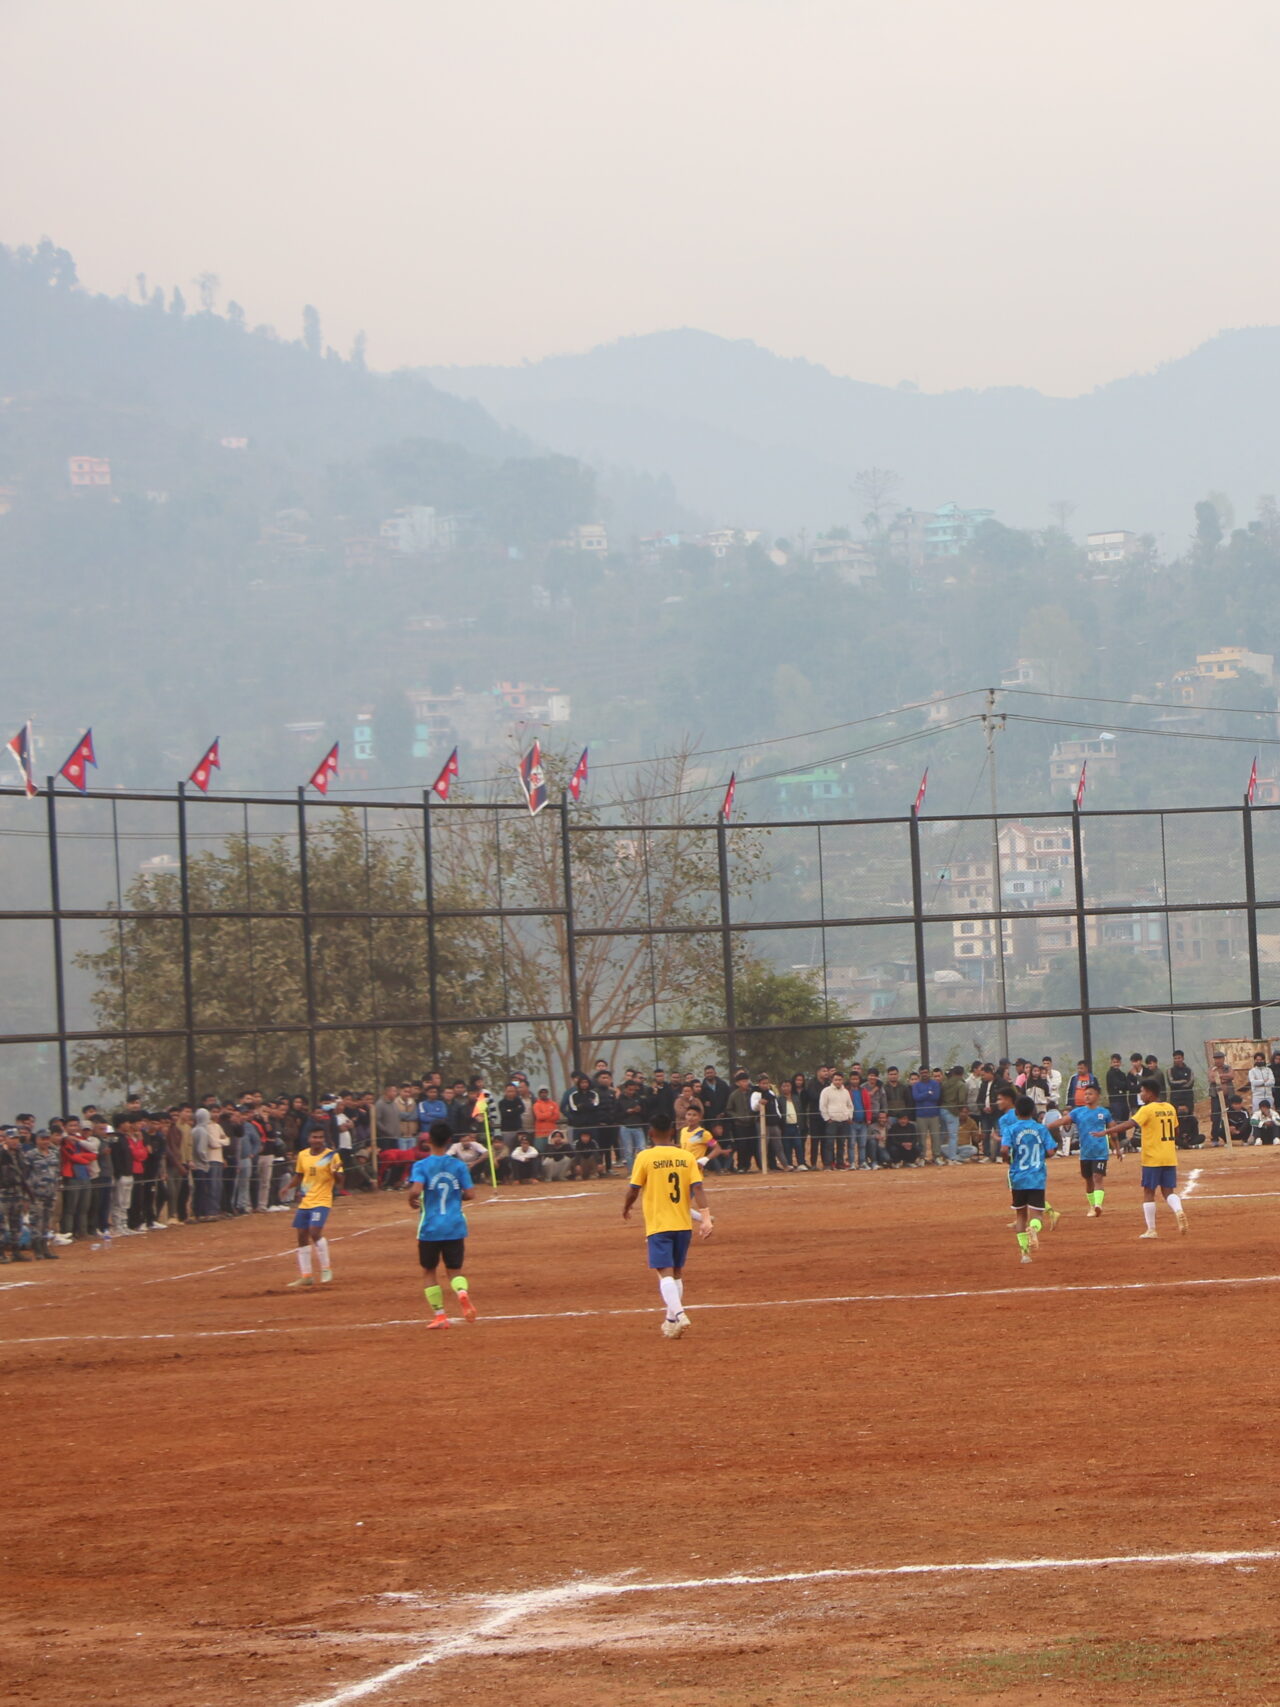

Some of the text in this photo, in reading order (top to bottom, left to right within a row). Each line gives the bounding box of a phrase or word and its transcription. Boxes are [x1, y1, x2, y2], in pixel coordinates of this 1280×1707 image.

[1160, 1119, 1175, 1142] 11
[653, 1159, 689, 1170] SHIVA DAL
[1018, 1143, 1041, 1171] 24
[437, 1182, 450, 1216] 7
[668, 1172, 680, 1204] 3
